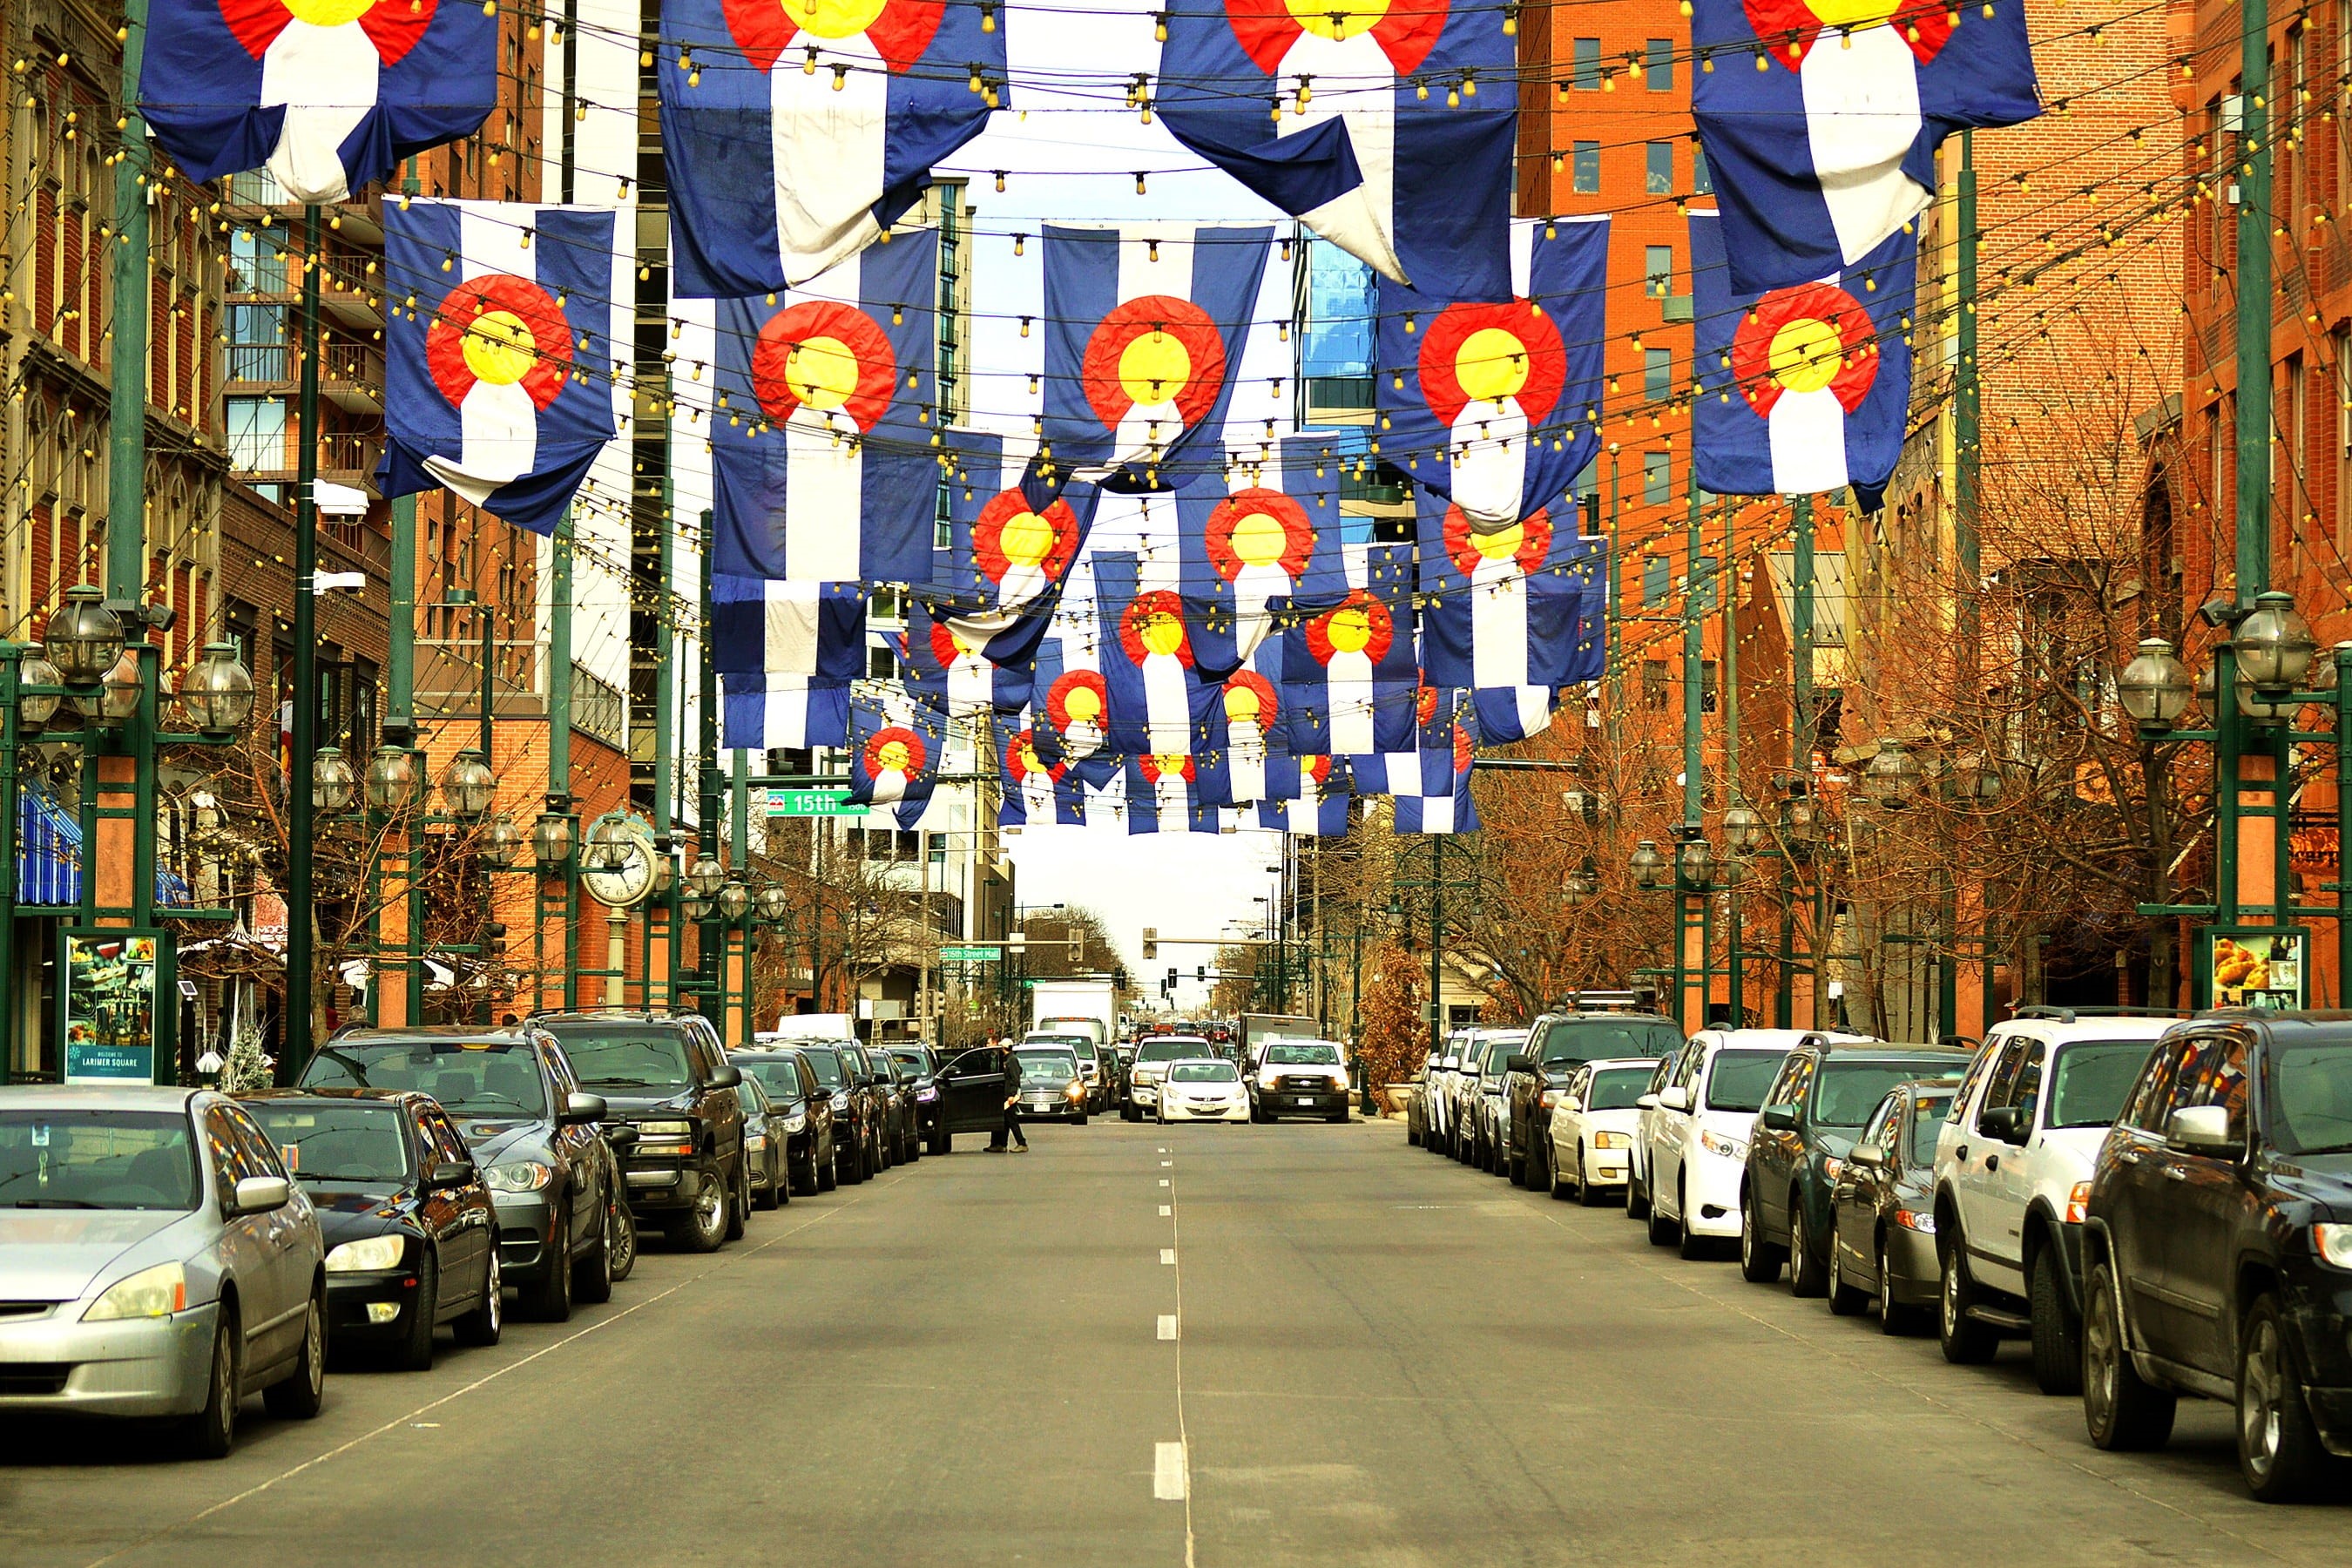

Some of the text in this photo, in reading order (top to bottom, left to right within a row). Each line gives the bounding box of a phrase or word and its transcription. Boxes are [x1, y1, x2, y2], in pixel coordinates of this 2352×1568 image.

[794, 794, 836, 812] 15th
[82, 1058, 138, 1067] LARIMER SQUARE
